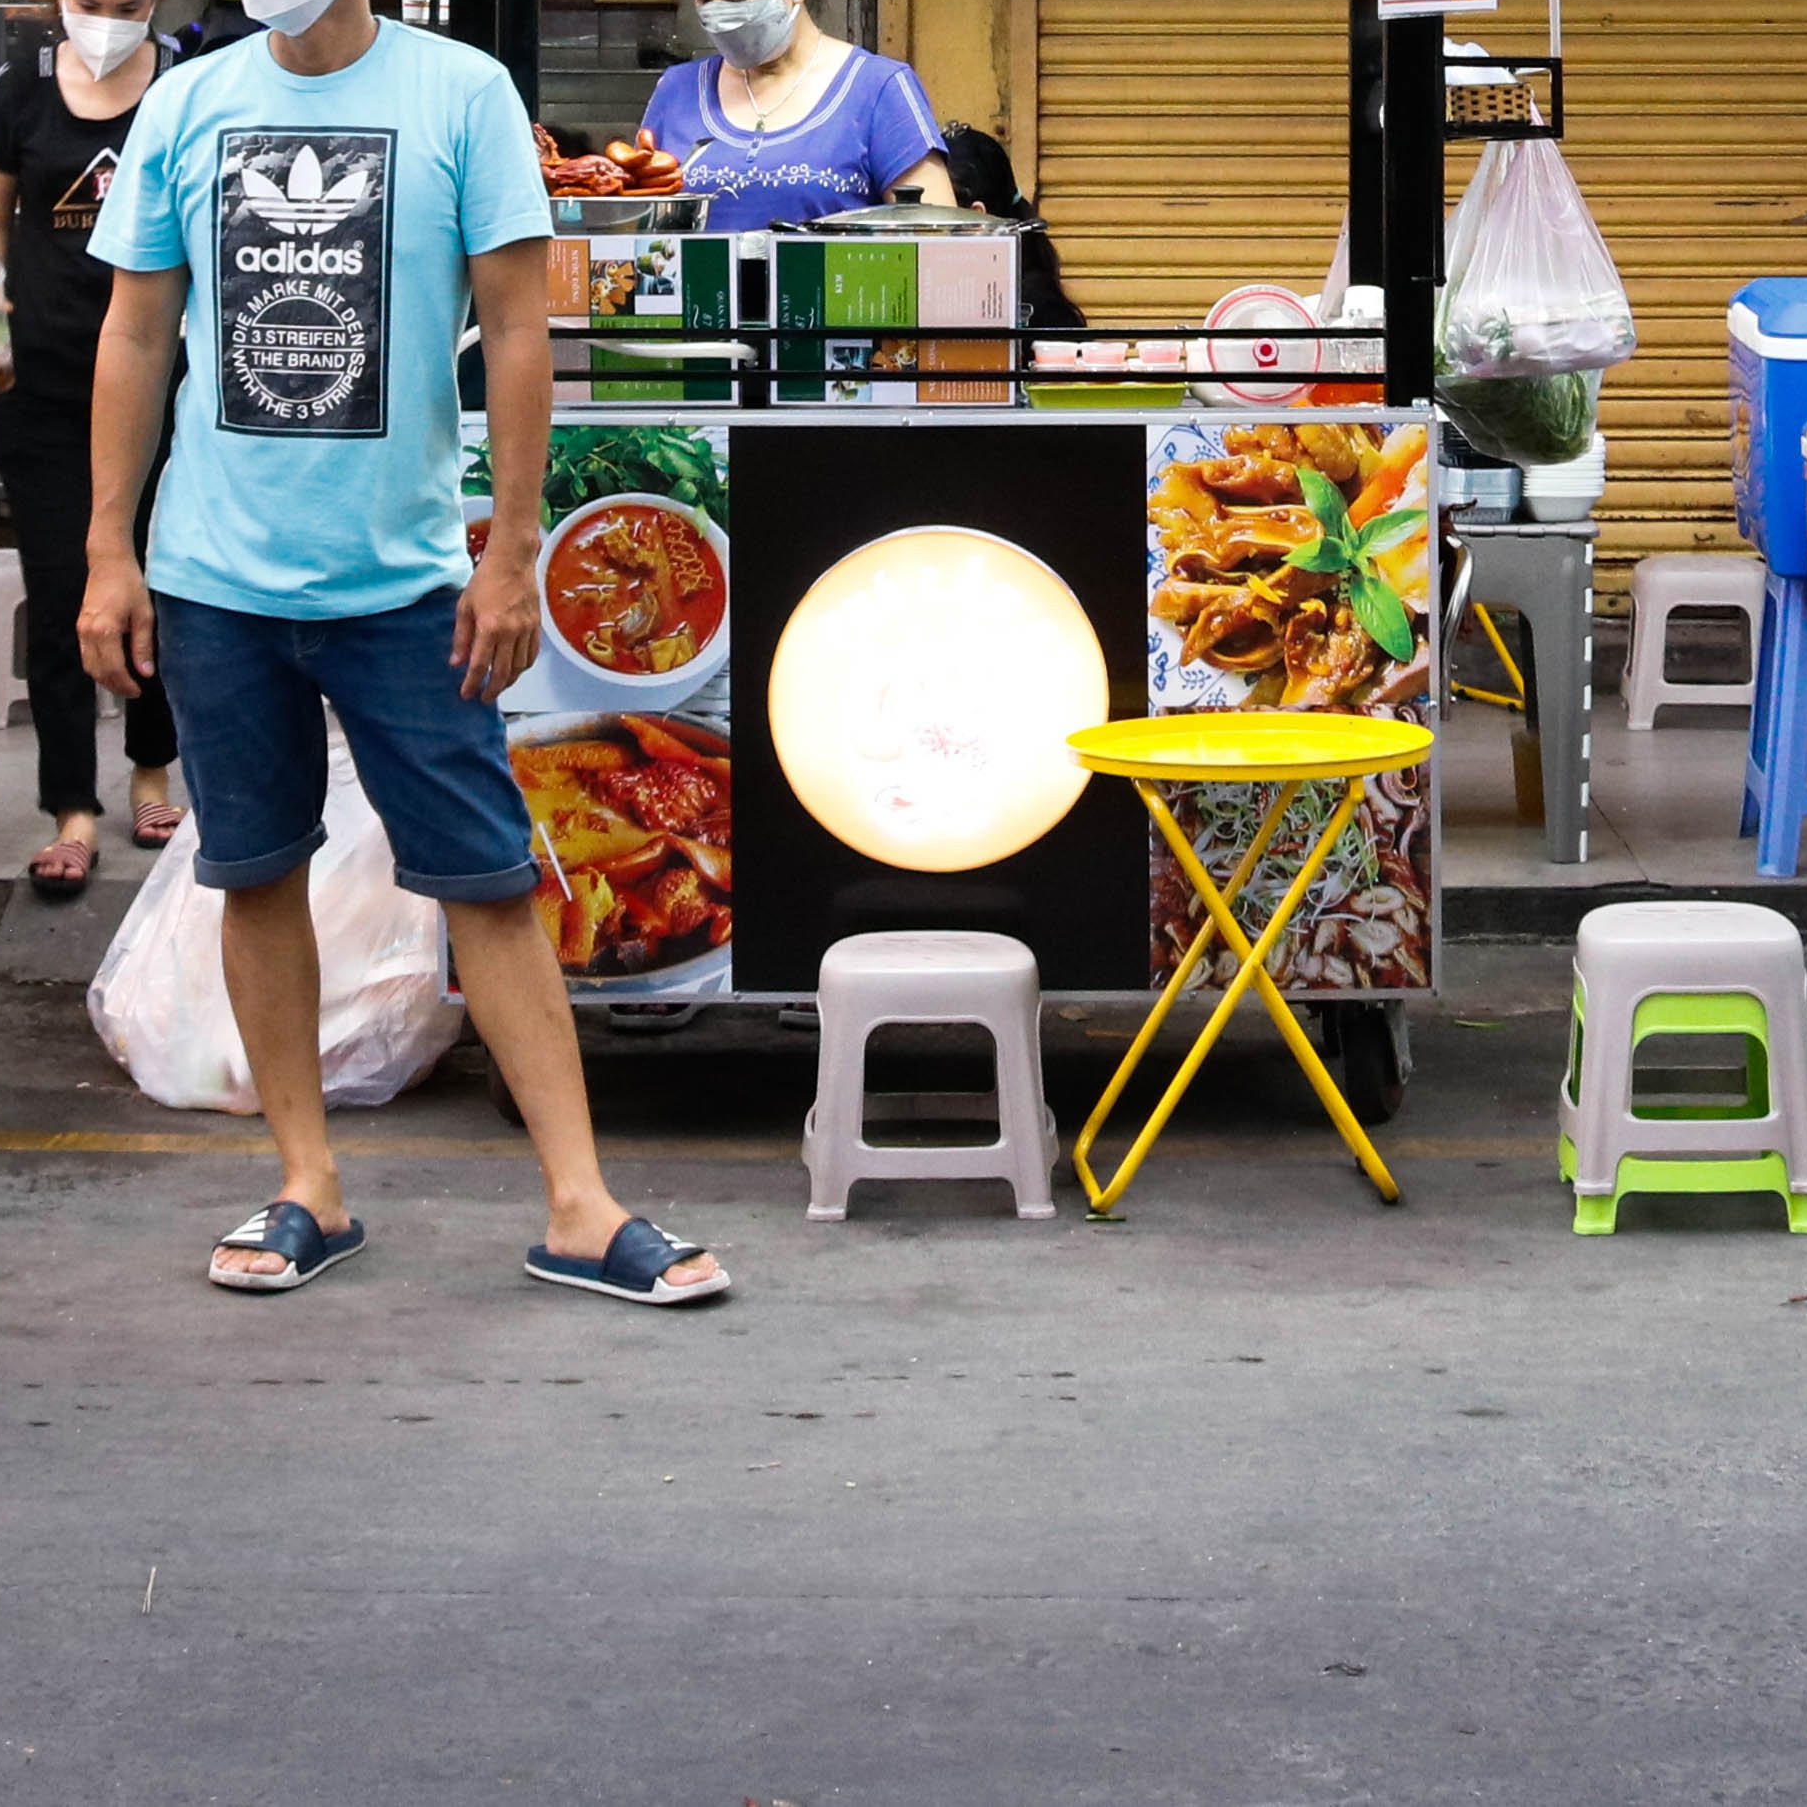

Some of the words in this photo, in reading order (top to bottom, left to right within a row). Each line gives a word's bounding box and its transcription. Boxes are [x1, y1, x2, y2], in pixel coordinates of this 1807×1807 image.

[235, 241, 364, 275] adidas
[232, 312, 252, 343] DIE
[246, 280, 311, 314] MARKE
[313, 283, 345, 309] MIT
[340, 307, 365, 346] DEN
[251, 330, 261, 344] 3
[265, 330, 346, 346] STREIFEN
[251, 351, 283, 366] THE
[288, 353, 345, 368] BRAND
[232, 349, 260, 397] WITH
[258, 392, 293, 418] THE
[297, 404, 308, 419] 3
[311, 352, 365, 417] STRIPES
